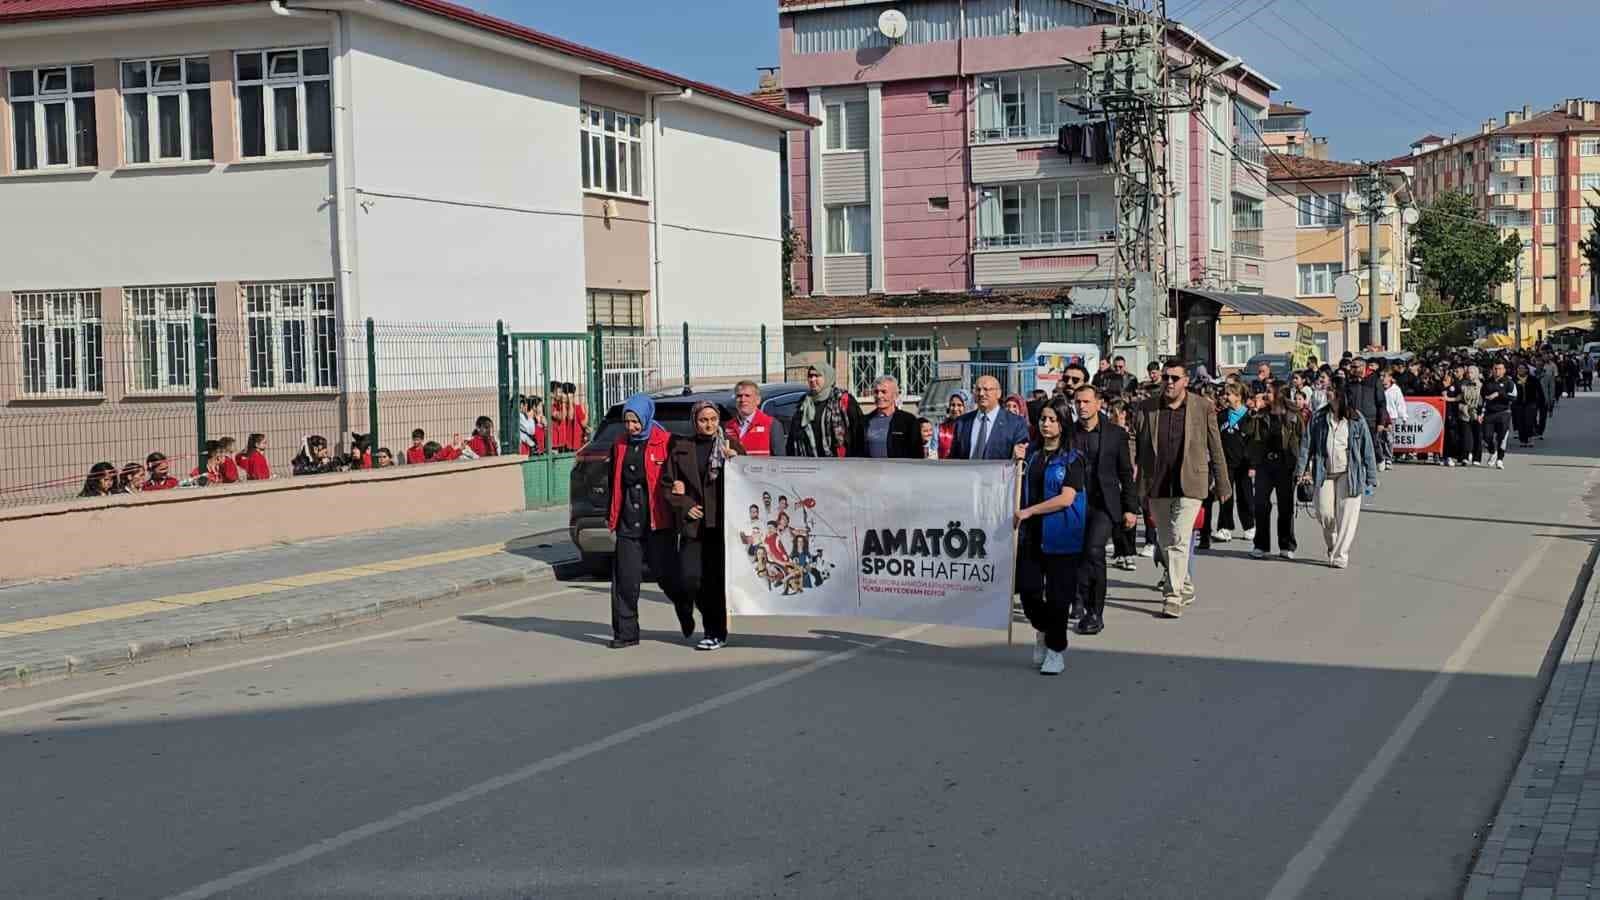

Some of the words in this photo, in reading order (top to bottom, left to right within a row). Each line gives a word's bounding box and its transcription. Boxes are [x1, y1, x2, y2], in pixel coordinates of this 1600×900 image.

[1392, 422, 1423, 433] EKNİK
[862, 521, 987, 559] AMATÖR
[862, 557, 915, 577] SPOR
[921, 560, 994, 583] HAFTASI
